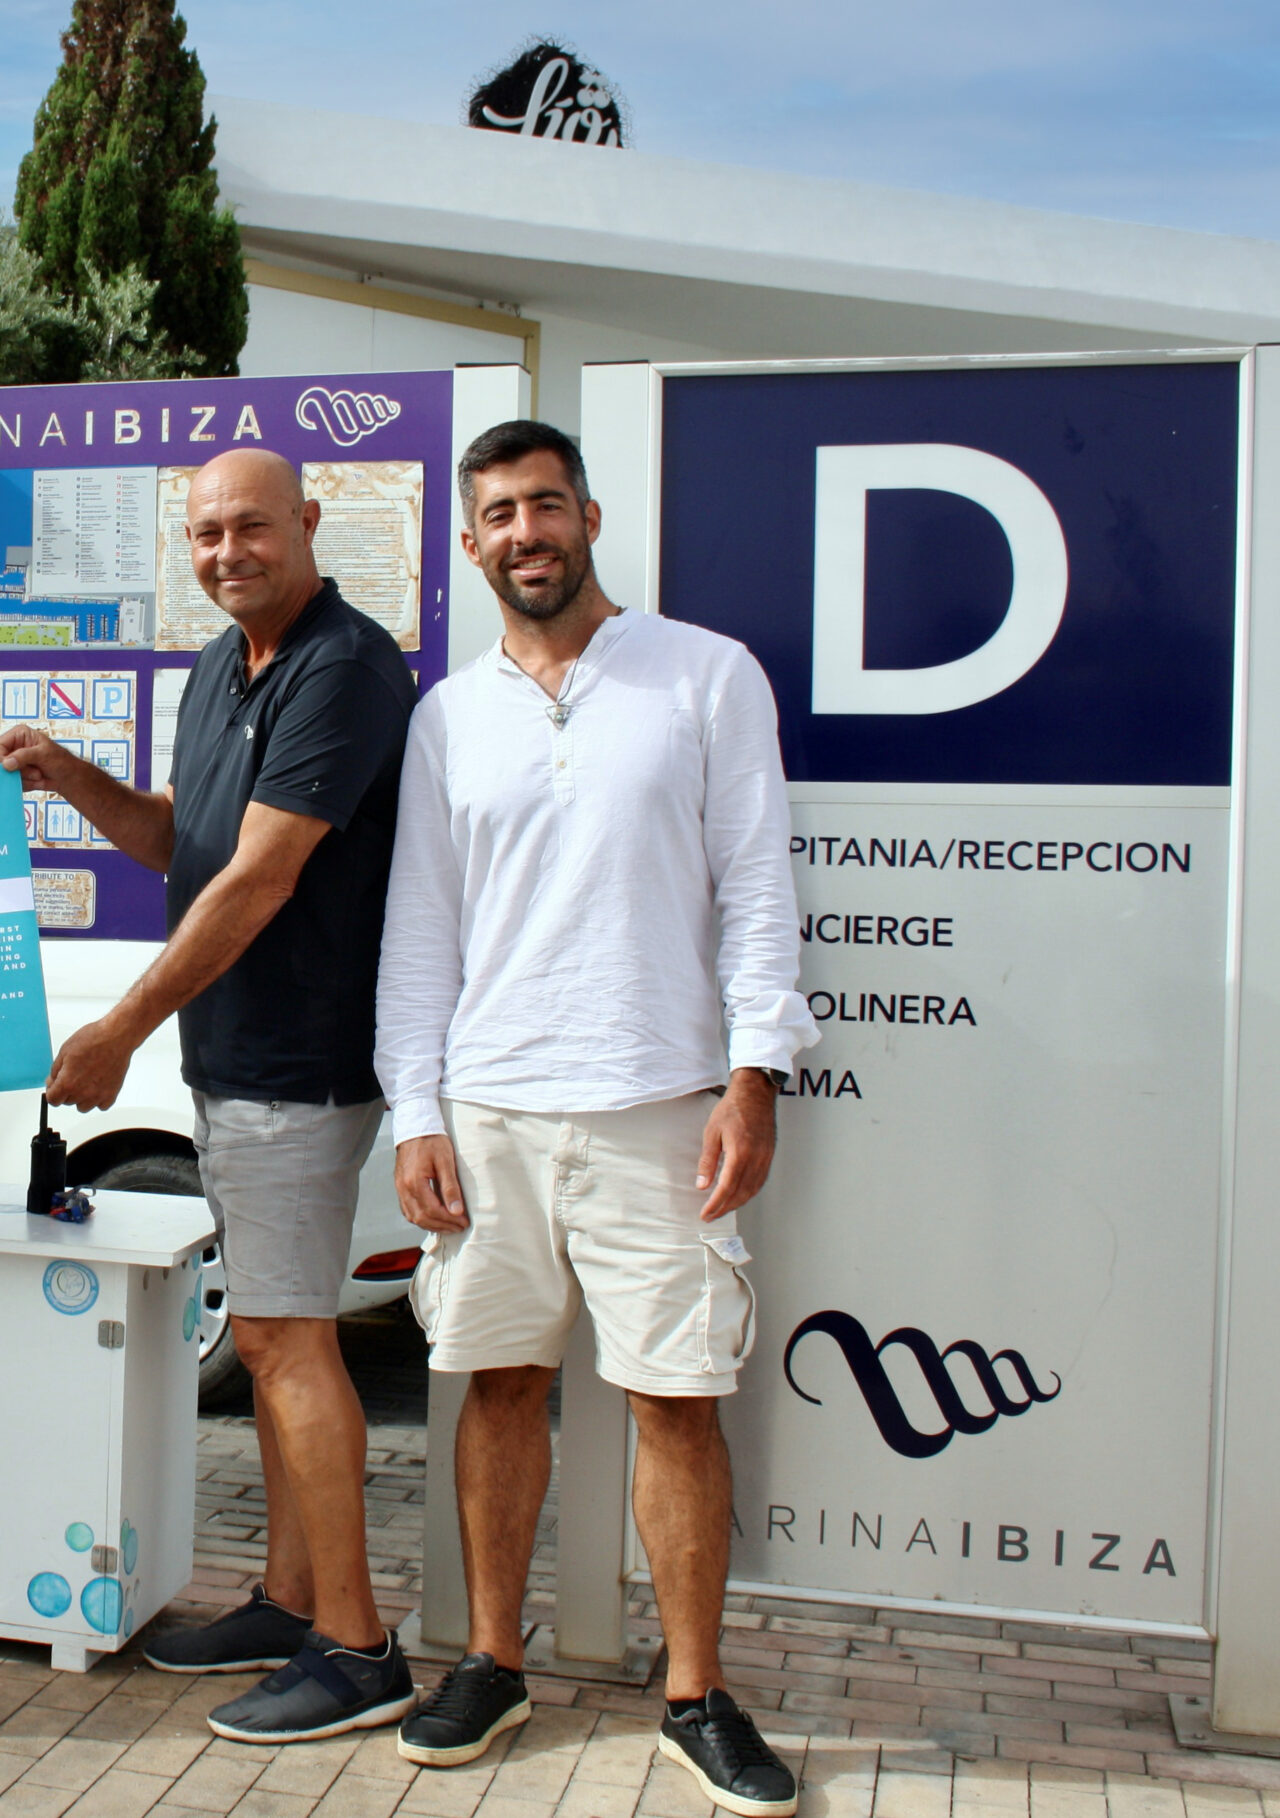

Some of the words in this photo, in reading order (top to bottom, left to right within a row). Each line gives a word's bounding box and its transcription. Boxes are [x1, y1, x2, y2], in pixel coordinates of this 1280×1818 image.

[811, 442, 1068, 715] D
[790, 836, 1191, 873] PITANIA/RECEPCION
[799, 913, 954, 948] NCIERGE
[3, 962, 26, 971] AND
[1, 991, 24, 1000] AND
[809, 990, 976, 1027] OLINERA
[779, 1067, 862, 1099] LMA
[730, 1504, 1177, 1577] RINAIBIZA
